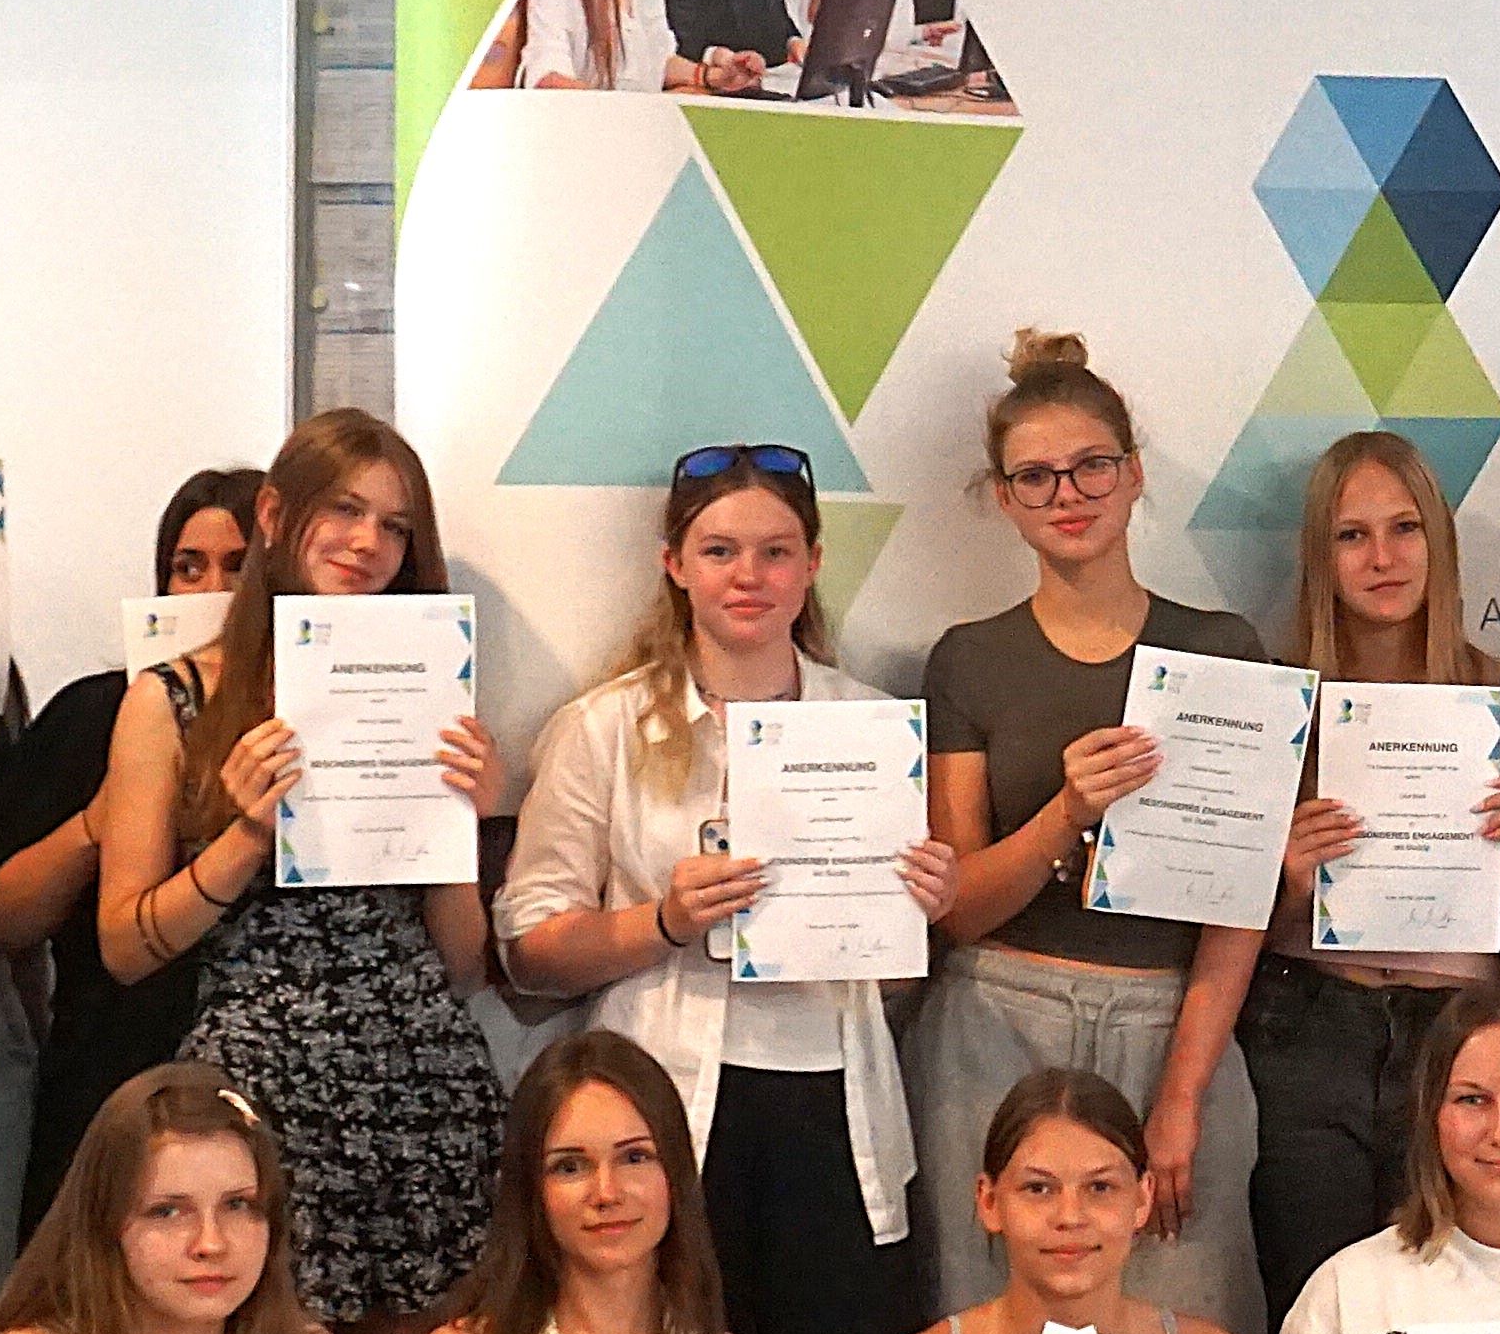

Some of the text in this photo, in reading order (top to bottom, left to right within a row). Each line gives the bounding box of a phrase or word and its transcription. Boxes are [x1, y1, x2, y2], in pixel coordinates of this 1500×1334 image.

[1176, 712, 1264, 733] ANERKENNUNG
[1368, 741, 1459, 753] ANERKENNUNG
[1412, 832, 1474, 841] ENGAGEMENT
